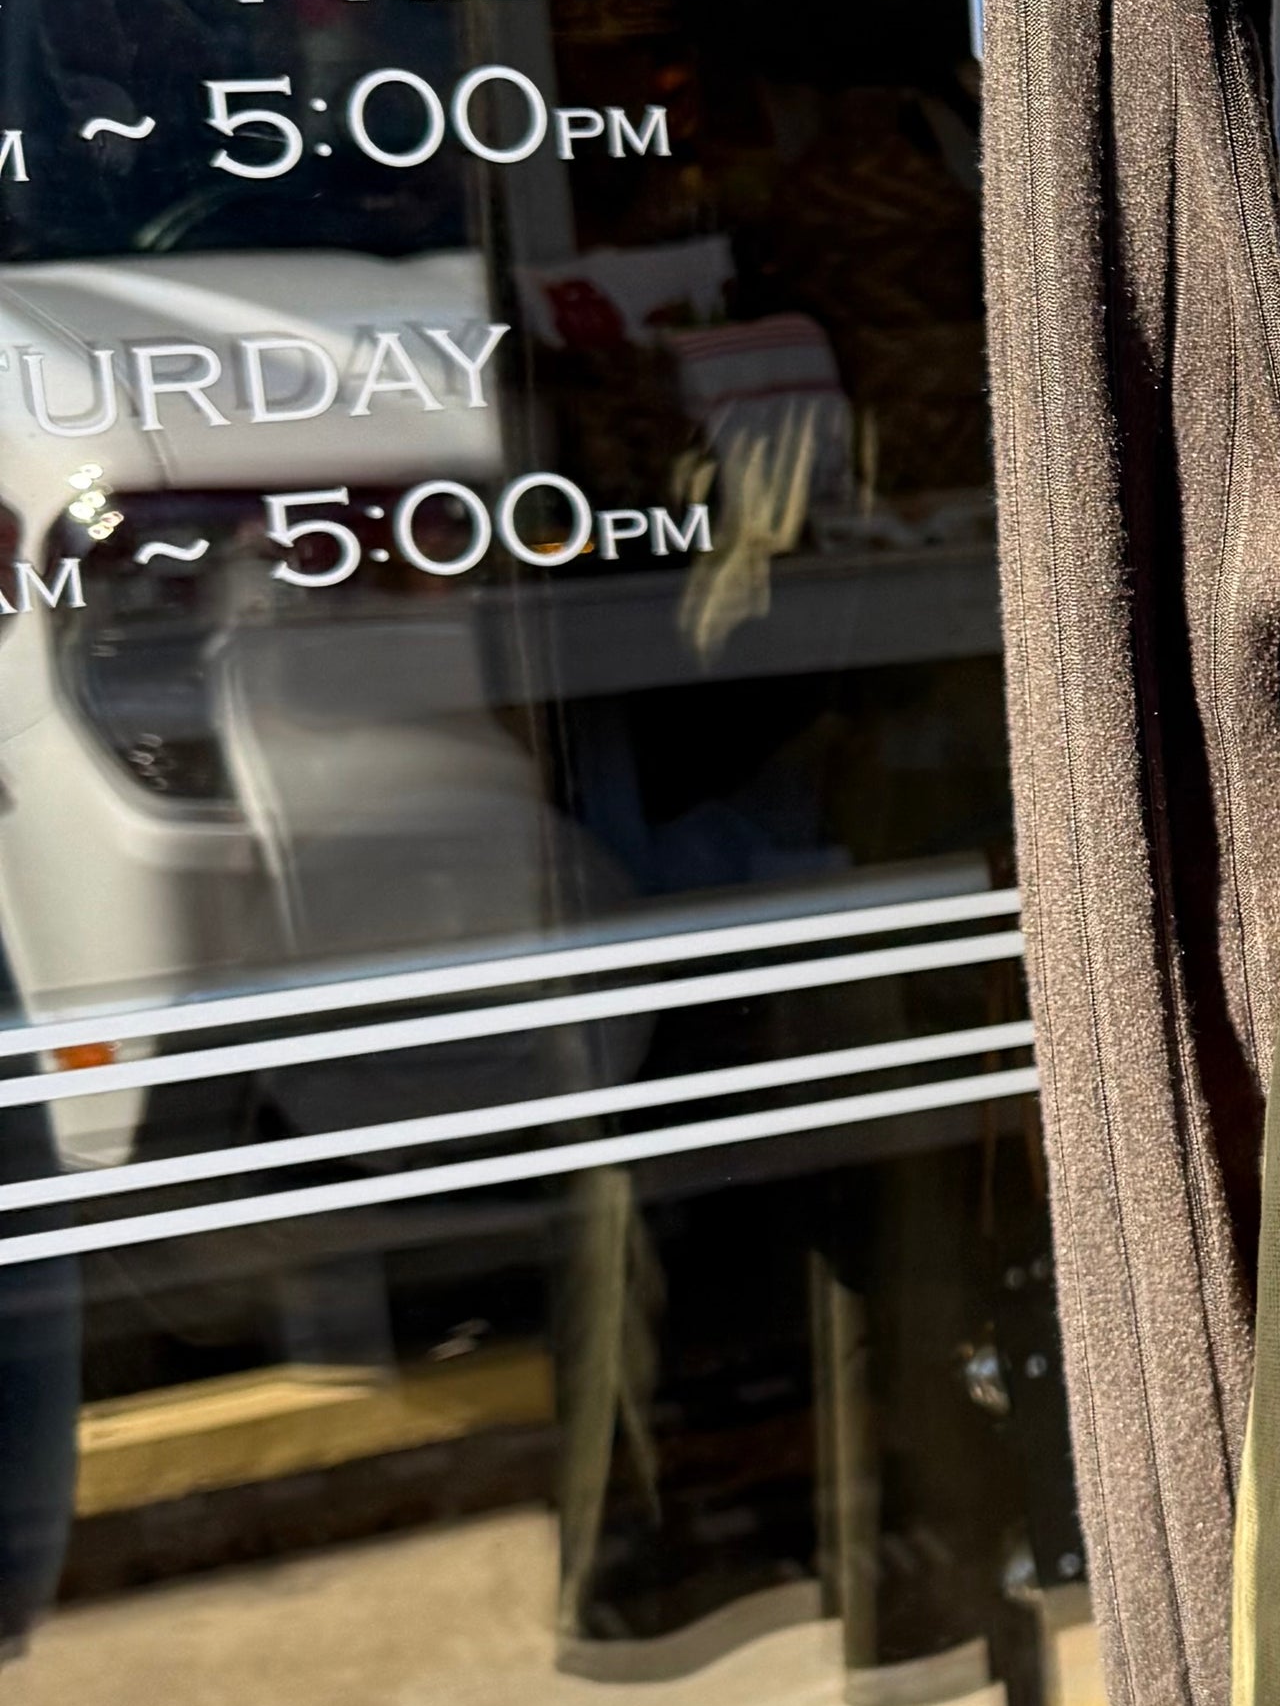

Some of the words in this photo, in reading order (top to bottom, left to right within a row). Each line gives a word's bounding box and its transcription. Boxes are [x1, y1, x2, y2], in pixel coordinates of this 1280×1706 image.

[204, 65, 672, 180] 5:00PM
[0, 323, 512, 438] URDAY
[263, 472, 714, 588] 5:00PM
